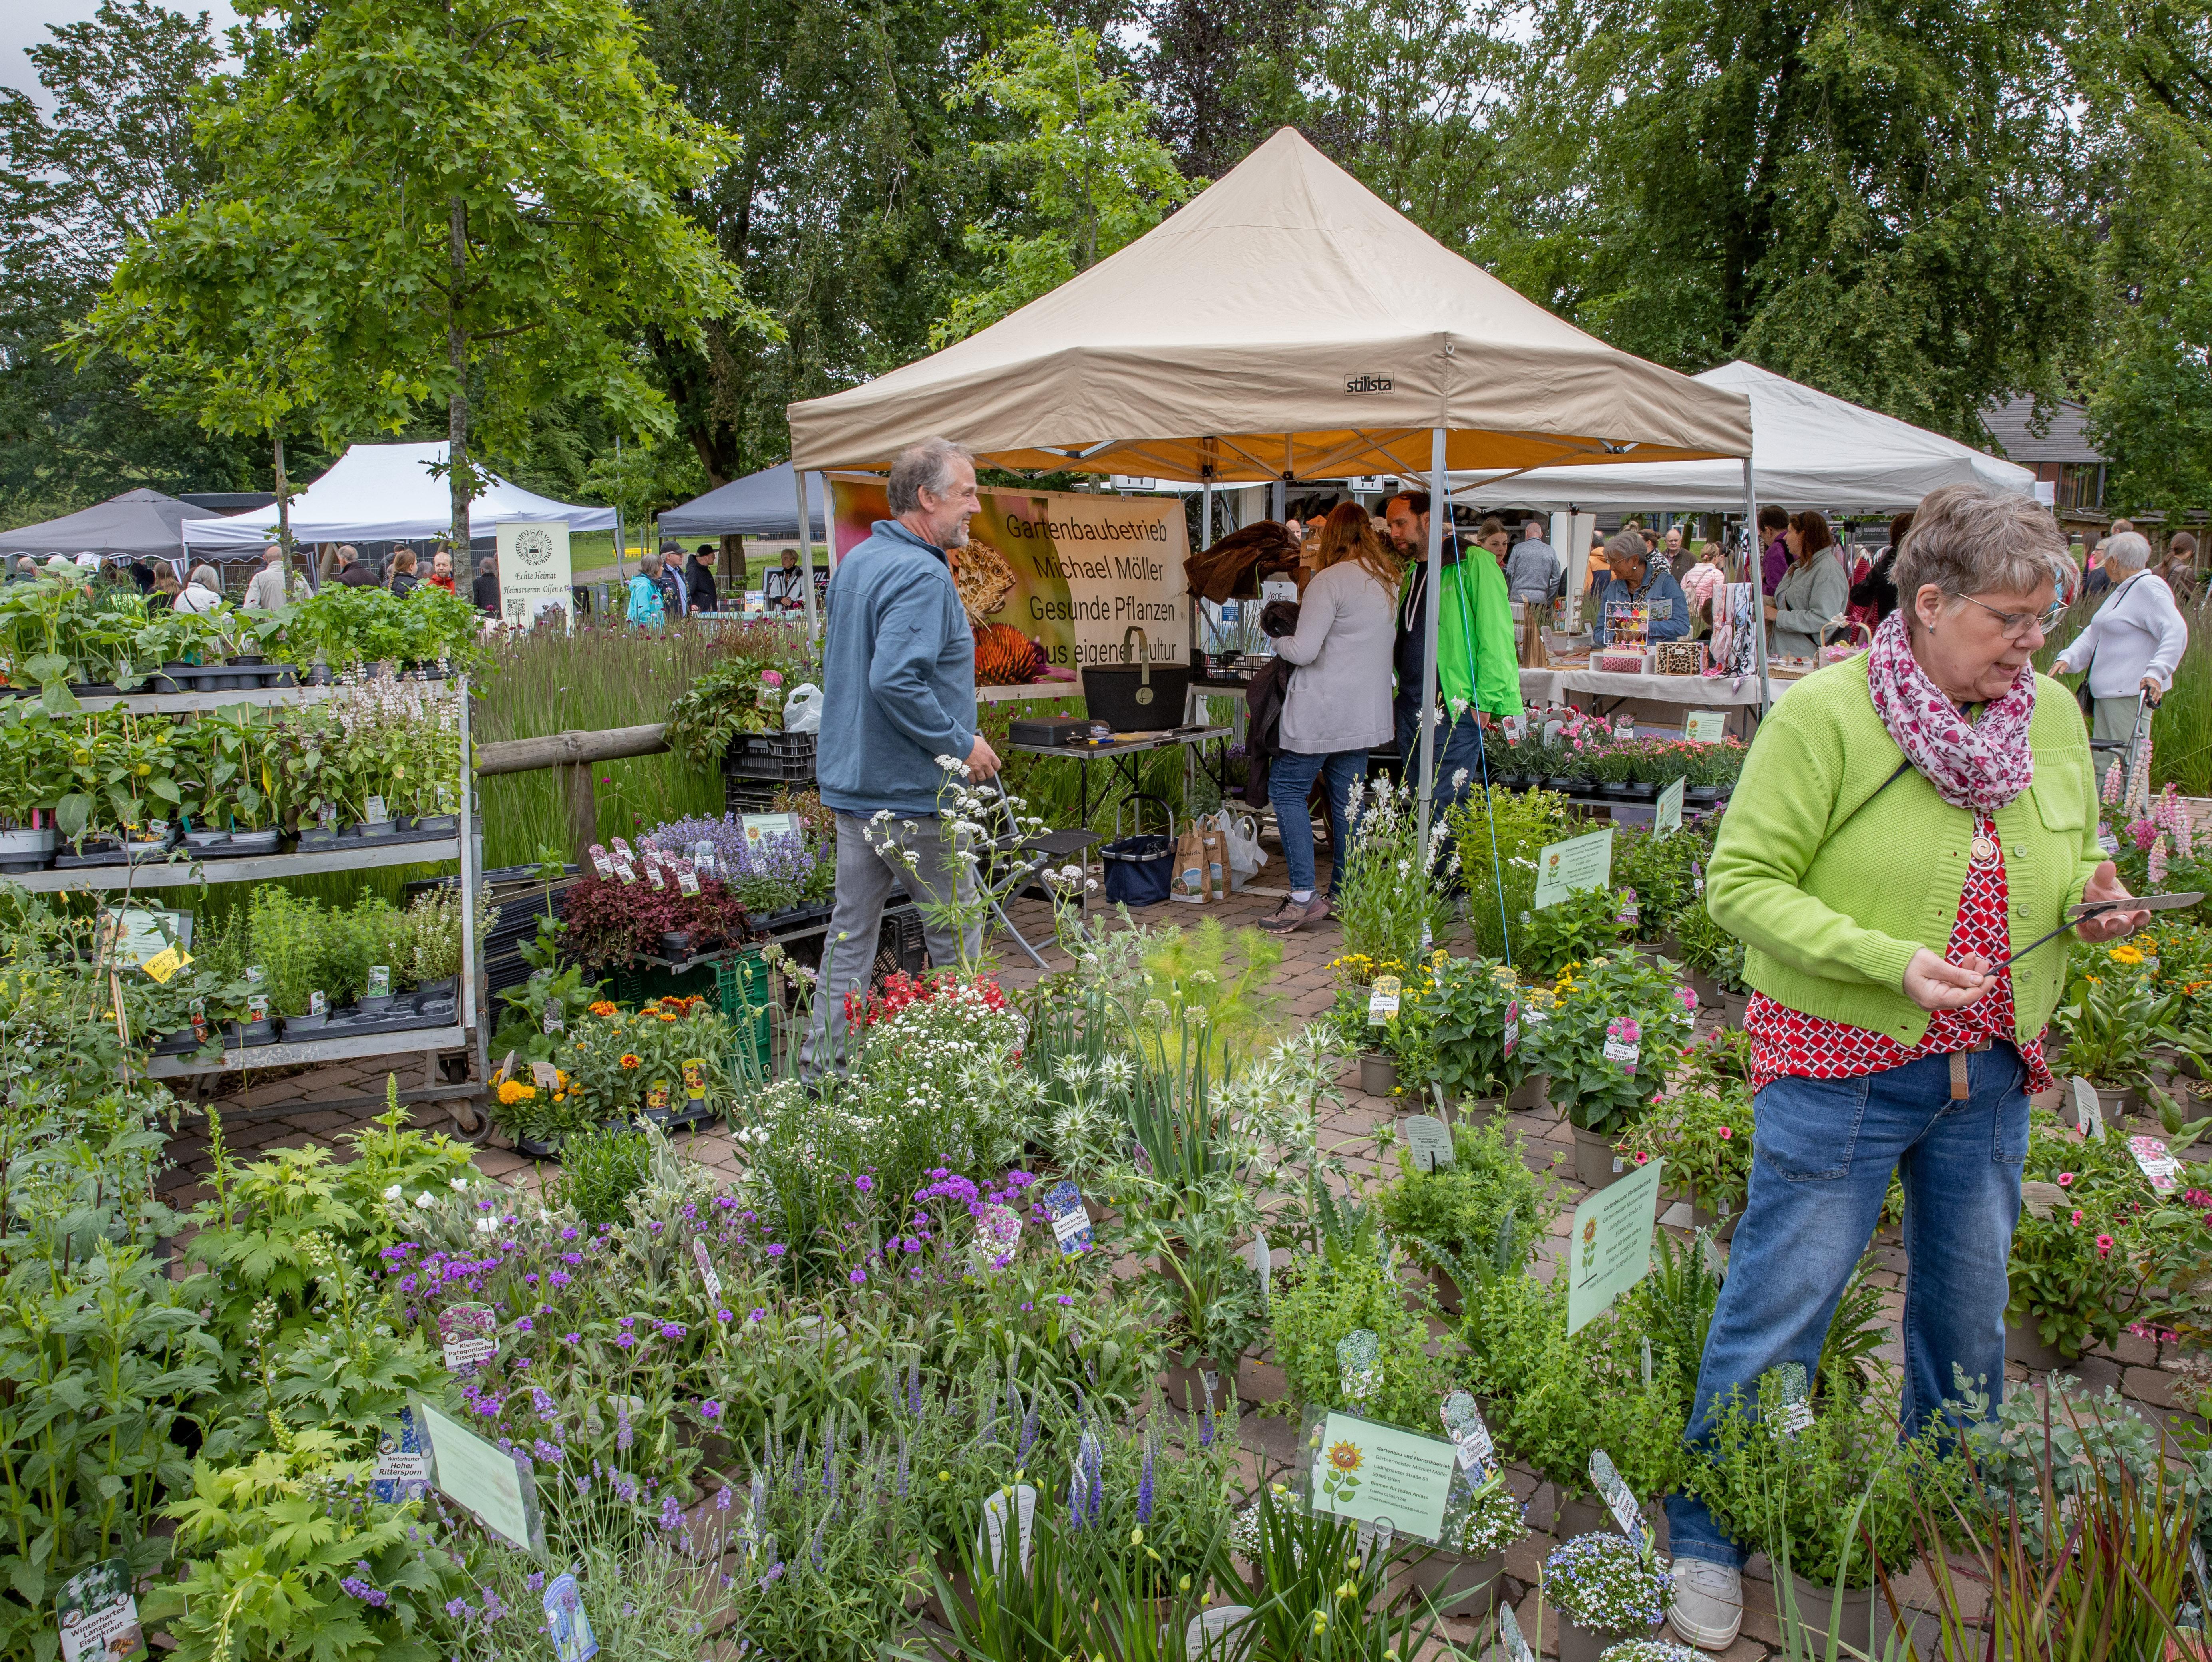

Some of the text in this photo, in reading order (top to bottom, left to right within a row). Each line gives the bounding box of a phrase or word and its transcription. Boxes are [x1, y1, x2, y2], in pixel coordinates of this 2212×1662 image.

[1347, 375, 1392, 393] stilista
[1007, 514, 1166, 542] Gartenbaubetrieb
[515, 571, 533, 580] Echte
[1032, 555, 1163, 581] Michael Möller
[504, 586, 540, 594] Heimatverein
[543, 584, 558, 595] Olfen
[1030, 595, 1175, 621] Gesunde Pflanzen
[1034, 644, 1068, 664] aus
[1604, 1197, 1621, 1212] Gartenbau
[1628, 1178, 1651, 1197] Floristikbetrieb
[1603, 1189, 1649, 1223] Gärtnermeister Michael Möller
[1057, 1217, 1088, 1236] Alpenmannstreu
[1058, 1214, 1083, 1229] Winterhartes
[1608, 1214, 1628, 1231] Lüdinghauser
[1628, 1207, 1639, 1218] Straße
[1615, 1221, 1634, 1237] 59399 Olfen
[1606, 1244, 1617, 1255] Blumen
[1622, 1233, 1632, 1245] jeden
[1631, 1226, 1641, 1237] Anlass
[1608, 1252, 1619, 1264] Telefon
[1588, 1280, 1597, 1290] Email
[448, 1344, 497, 1356] Patagonisches
[460, 1340, 484, 1349] Kleines
[456, 1350, 488, 1361] Eisenkra
[1462, 1434, 1481, 1448] Winterhartes
[1466, 1439, 1482, 1453] Blaues
[1377, 1446, 1402, 1457] Gartenbau
[1414, 1456, 1451, 1469] Floristikbetrieb
[1466, 1445, 1487, 1463] Liebchen
[1374, 1463, 1406, 1476] Lüdinghauser
[1375, 1455, 1411, 1467] Gärtnermeister
[1412, 1464, 1431, 1473] Michael
[1371, 1481, 1389, 1489] Blumen
[1384, 1492, 1407, 1502] 02595/1248
[1379, 1498, 1429, 1515] fammoeller1303@aol.com
[1621, 1498, 1630, 1515] Blaues
[1624, 1502, 1634, 1523] Liebchen
[71, 1606, 126, 1637] Winterhartes
[83, 1619, 116, 1638] Lanzen-
[79, 1620, 124, 1648] Eisenkraut
